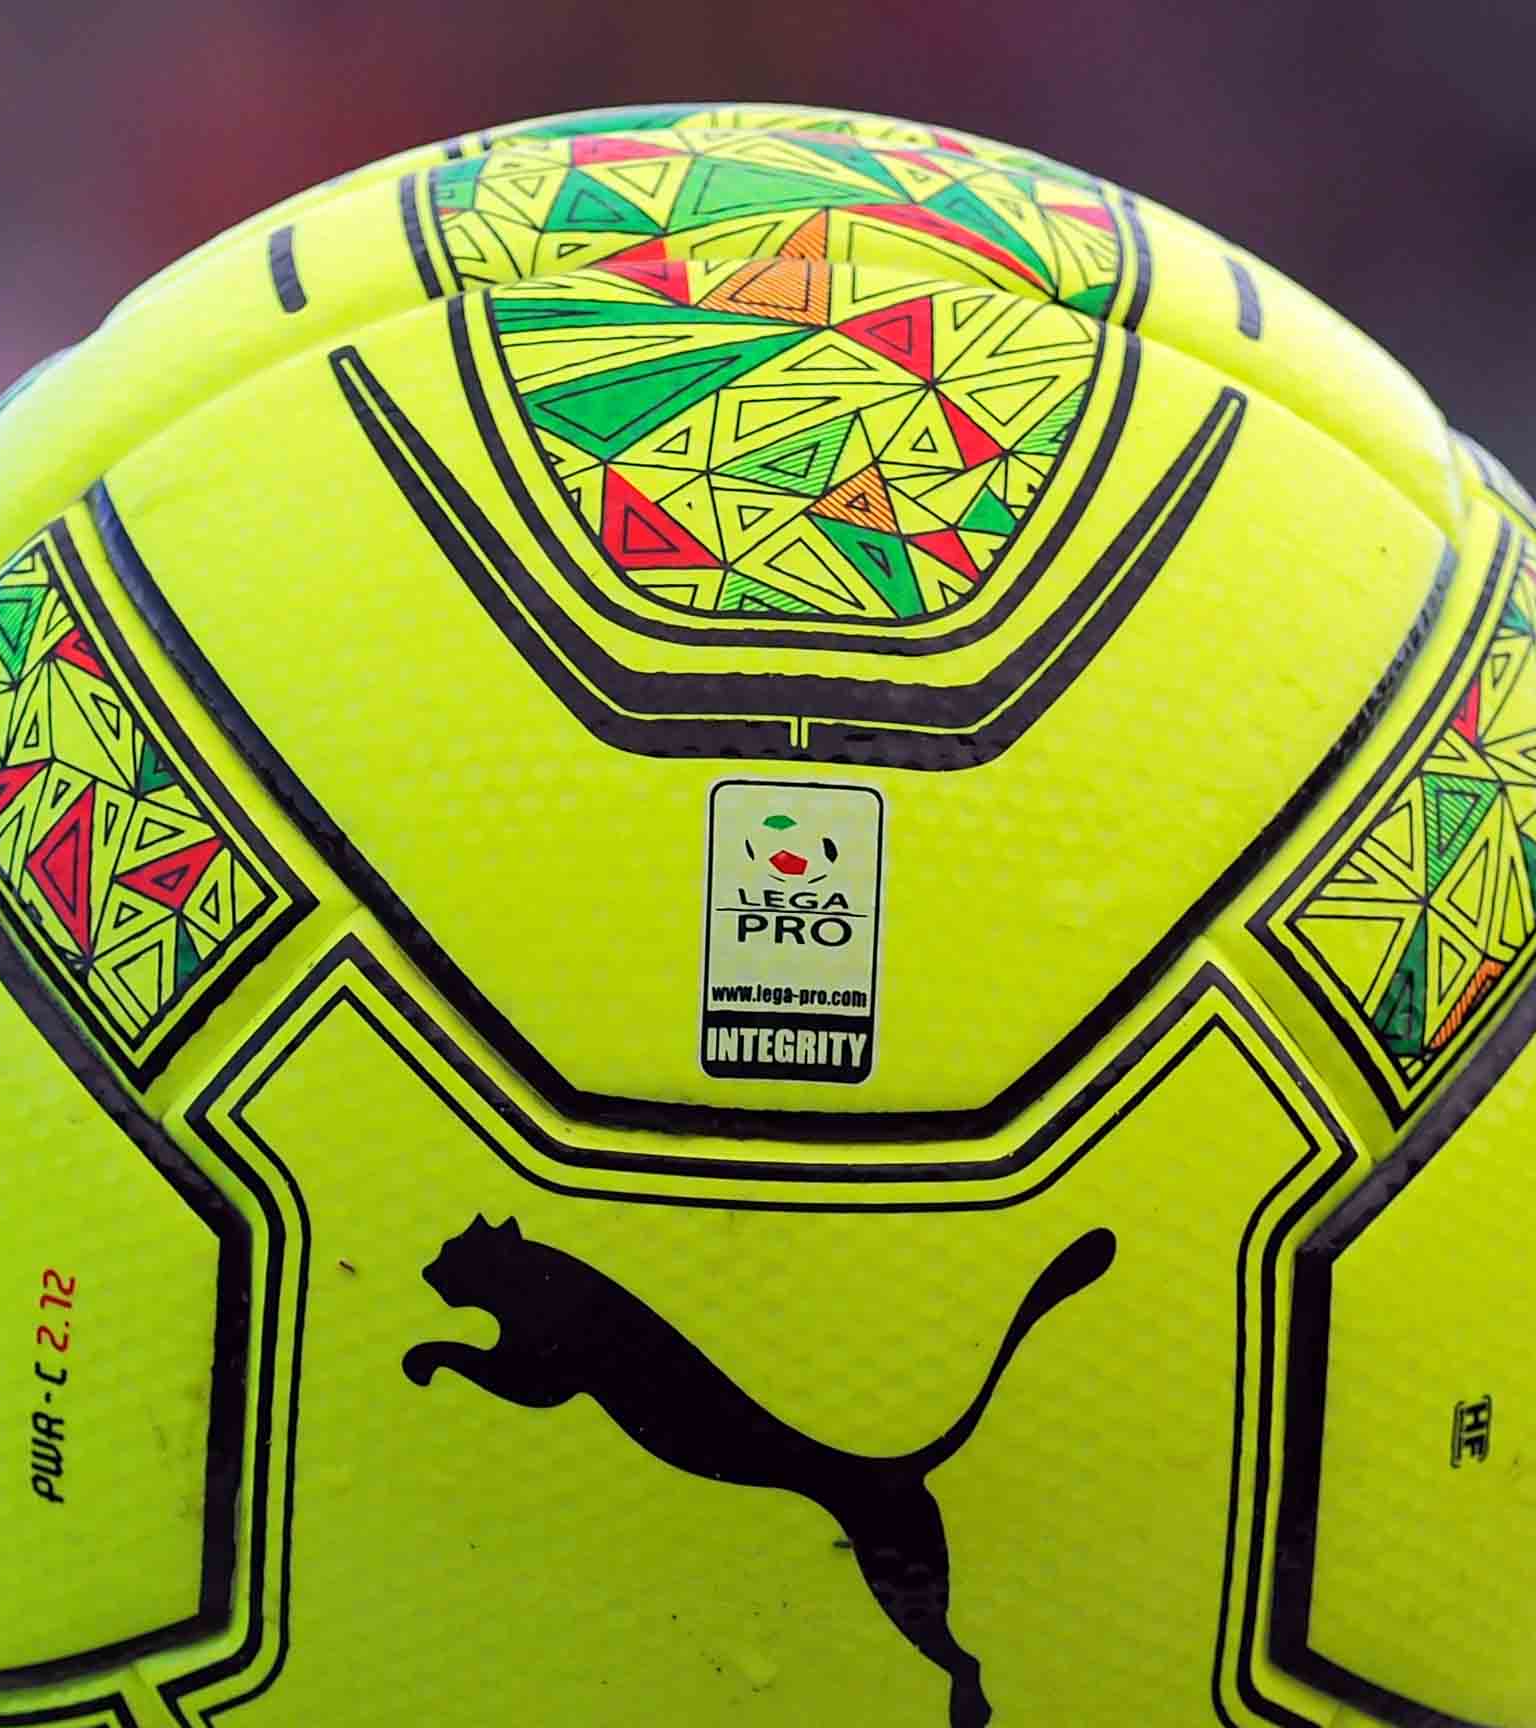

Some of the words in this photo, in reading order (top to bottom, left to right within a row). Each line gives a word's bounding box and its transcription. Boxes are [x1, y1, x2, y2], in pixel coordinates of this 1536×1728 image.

[737, 888, 849, 909] LEGA
[737, 914, 853, 947] PRO
[711, 984, 867, 1008] www.lega-pro.com
[706, 1027, 867, 1067] INTEGRITY
[36, 1268, 76, 1353] 2.12
